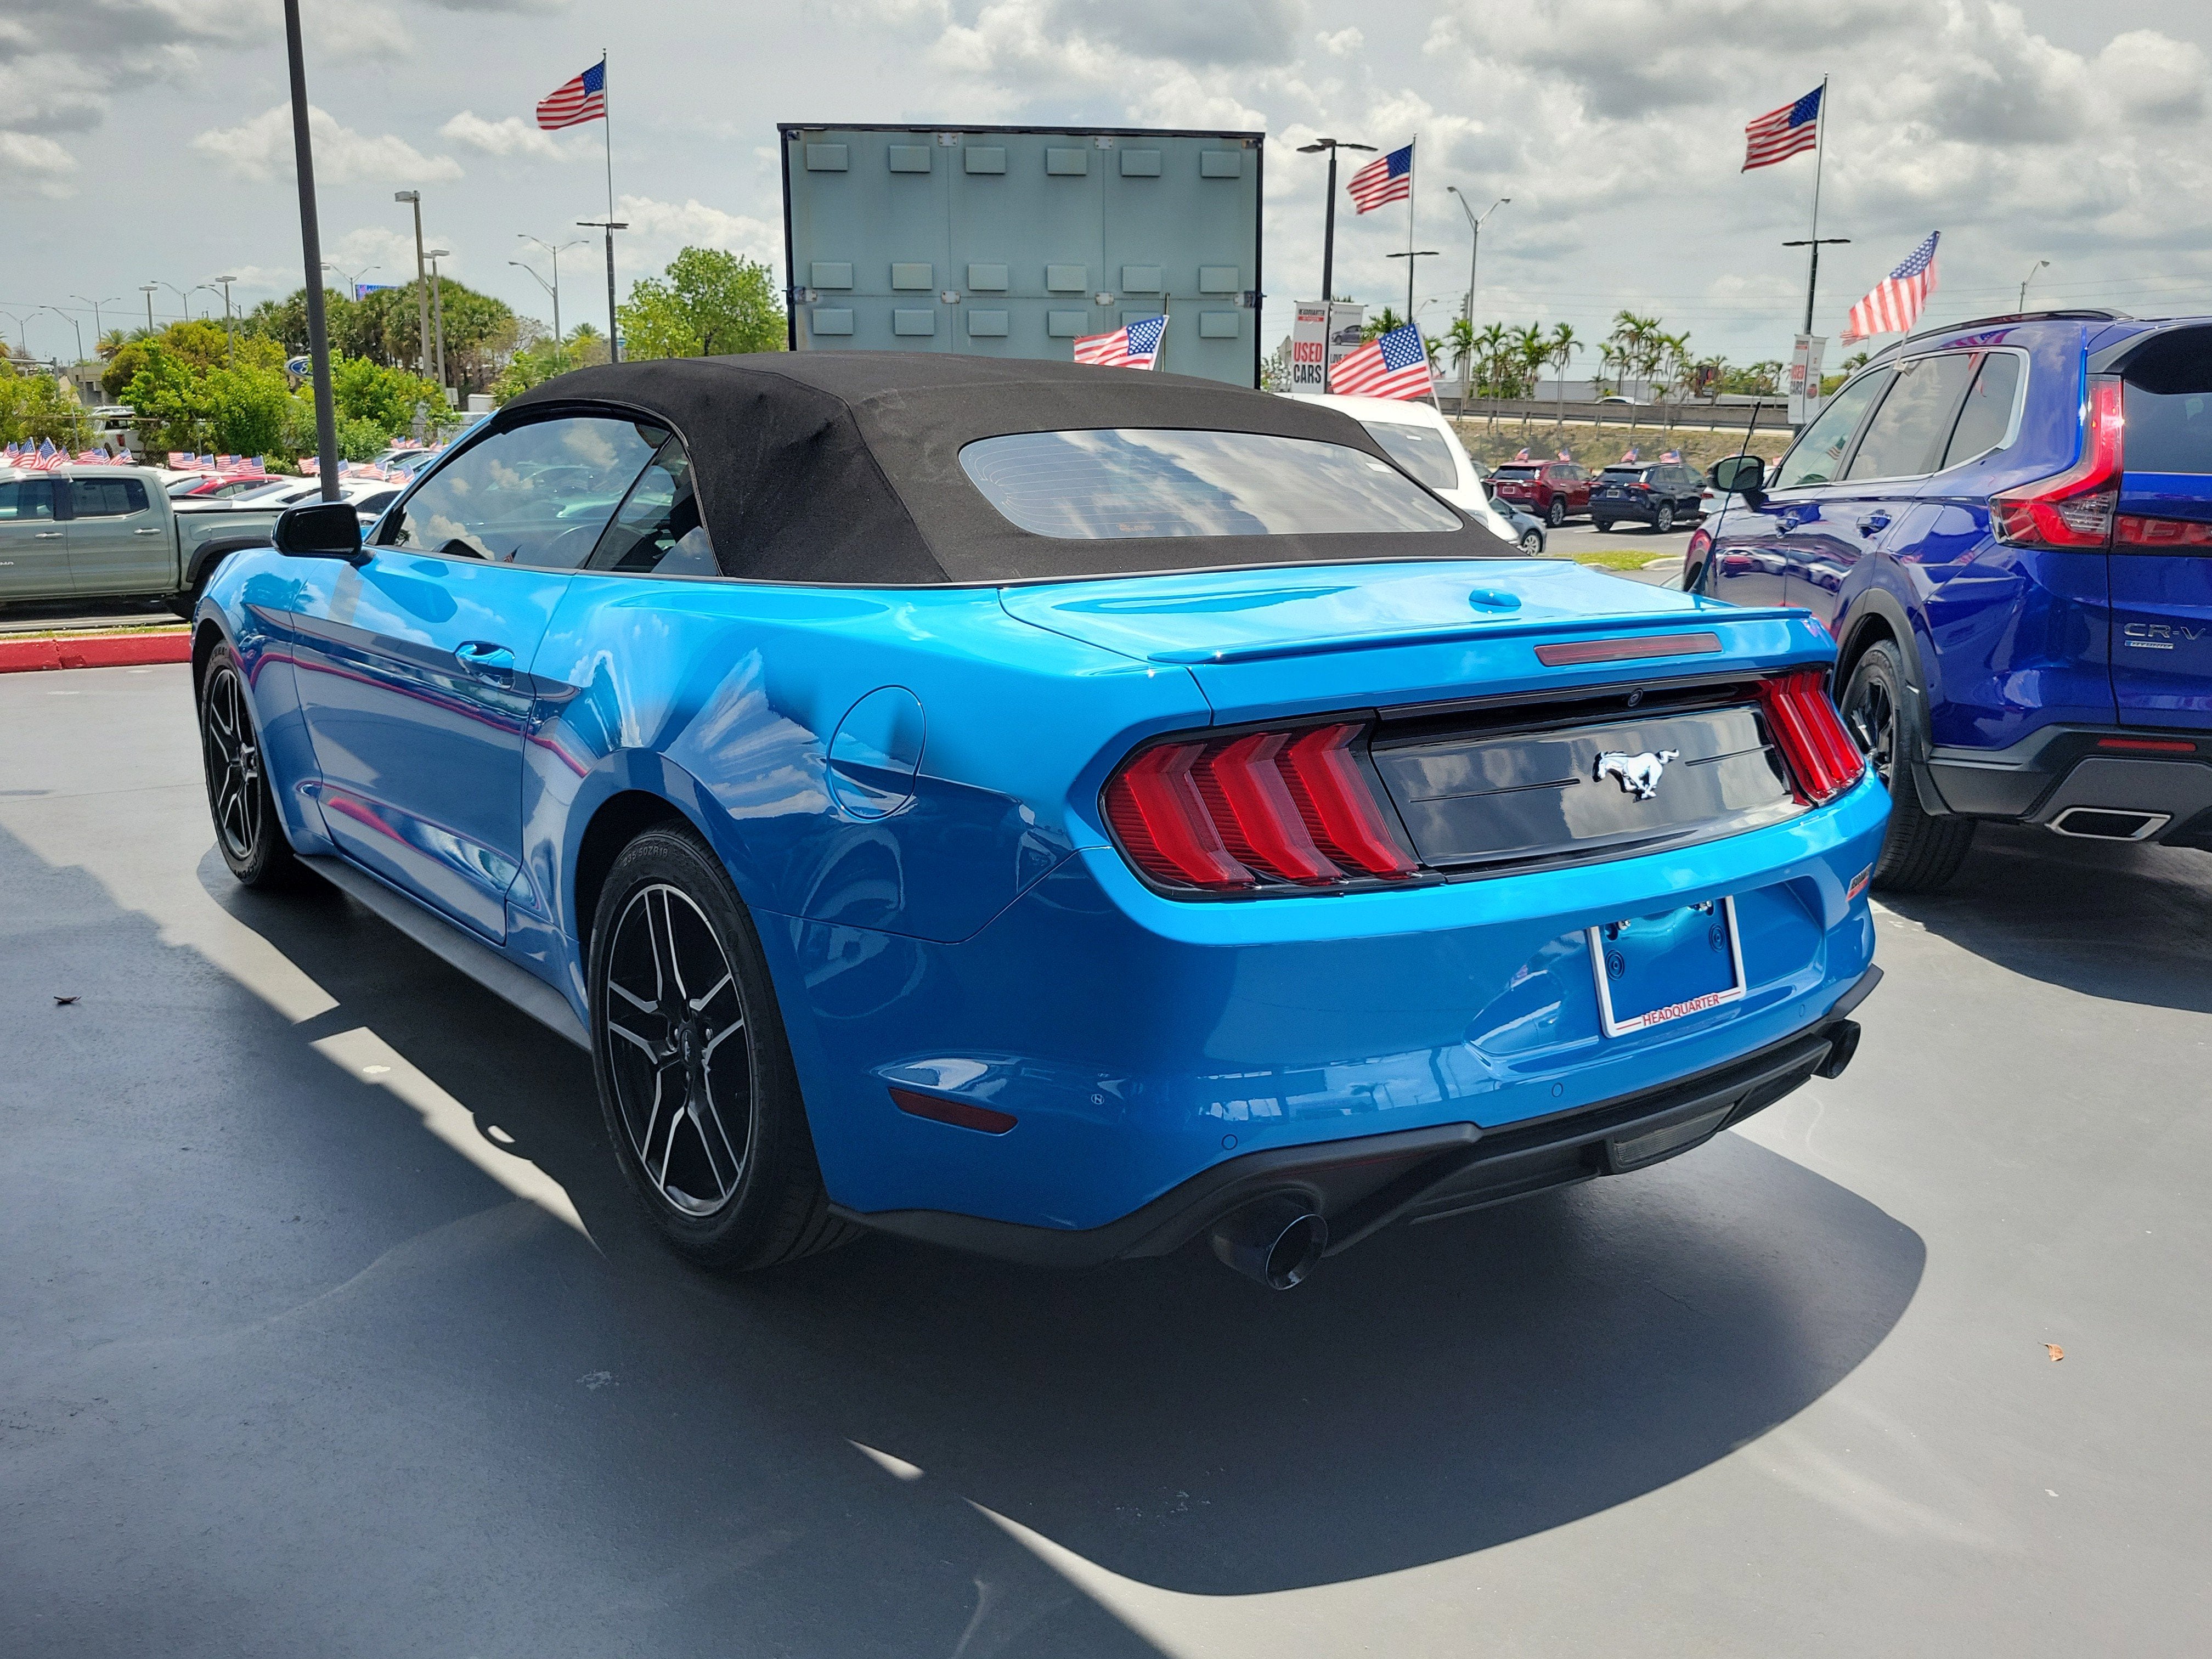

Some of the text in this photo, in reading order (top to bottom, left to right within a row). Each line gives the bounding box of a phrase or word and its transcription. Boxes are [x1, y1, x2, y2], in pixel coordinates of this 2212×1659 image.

[1294, 342, 1322, 362] USED
[1294, 364, 1322, 384] CARS
[2124, 623, 2205, 640] CR-V
[1642, 994, 1720, 1026] HEADQUARTER
